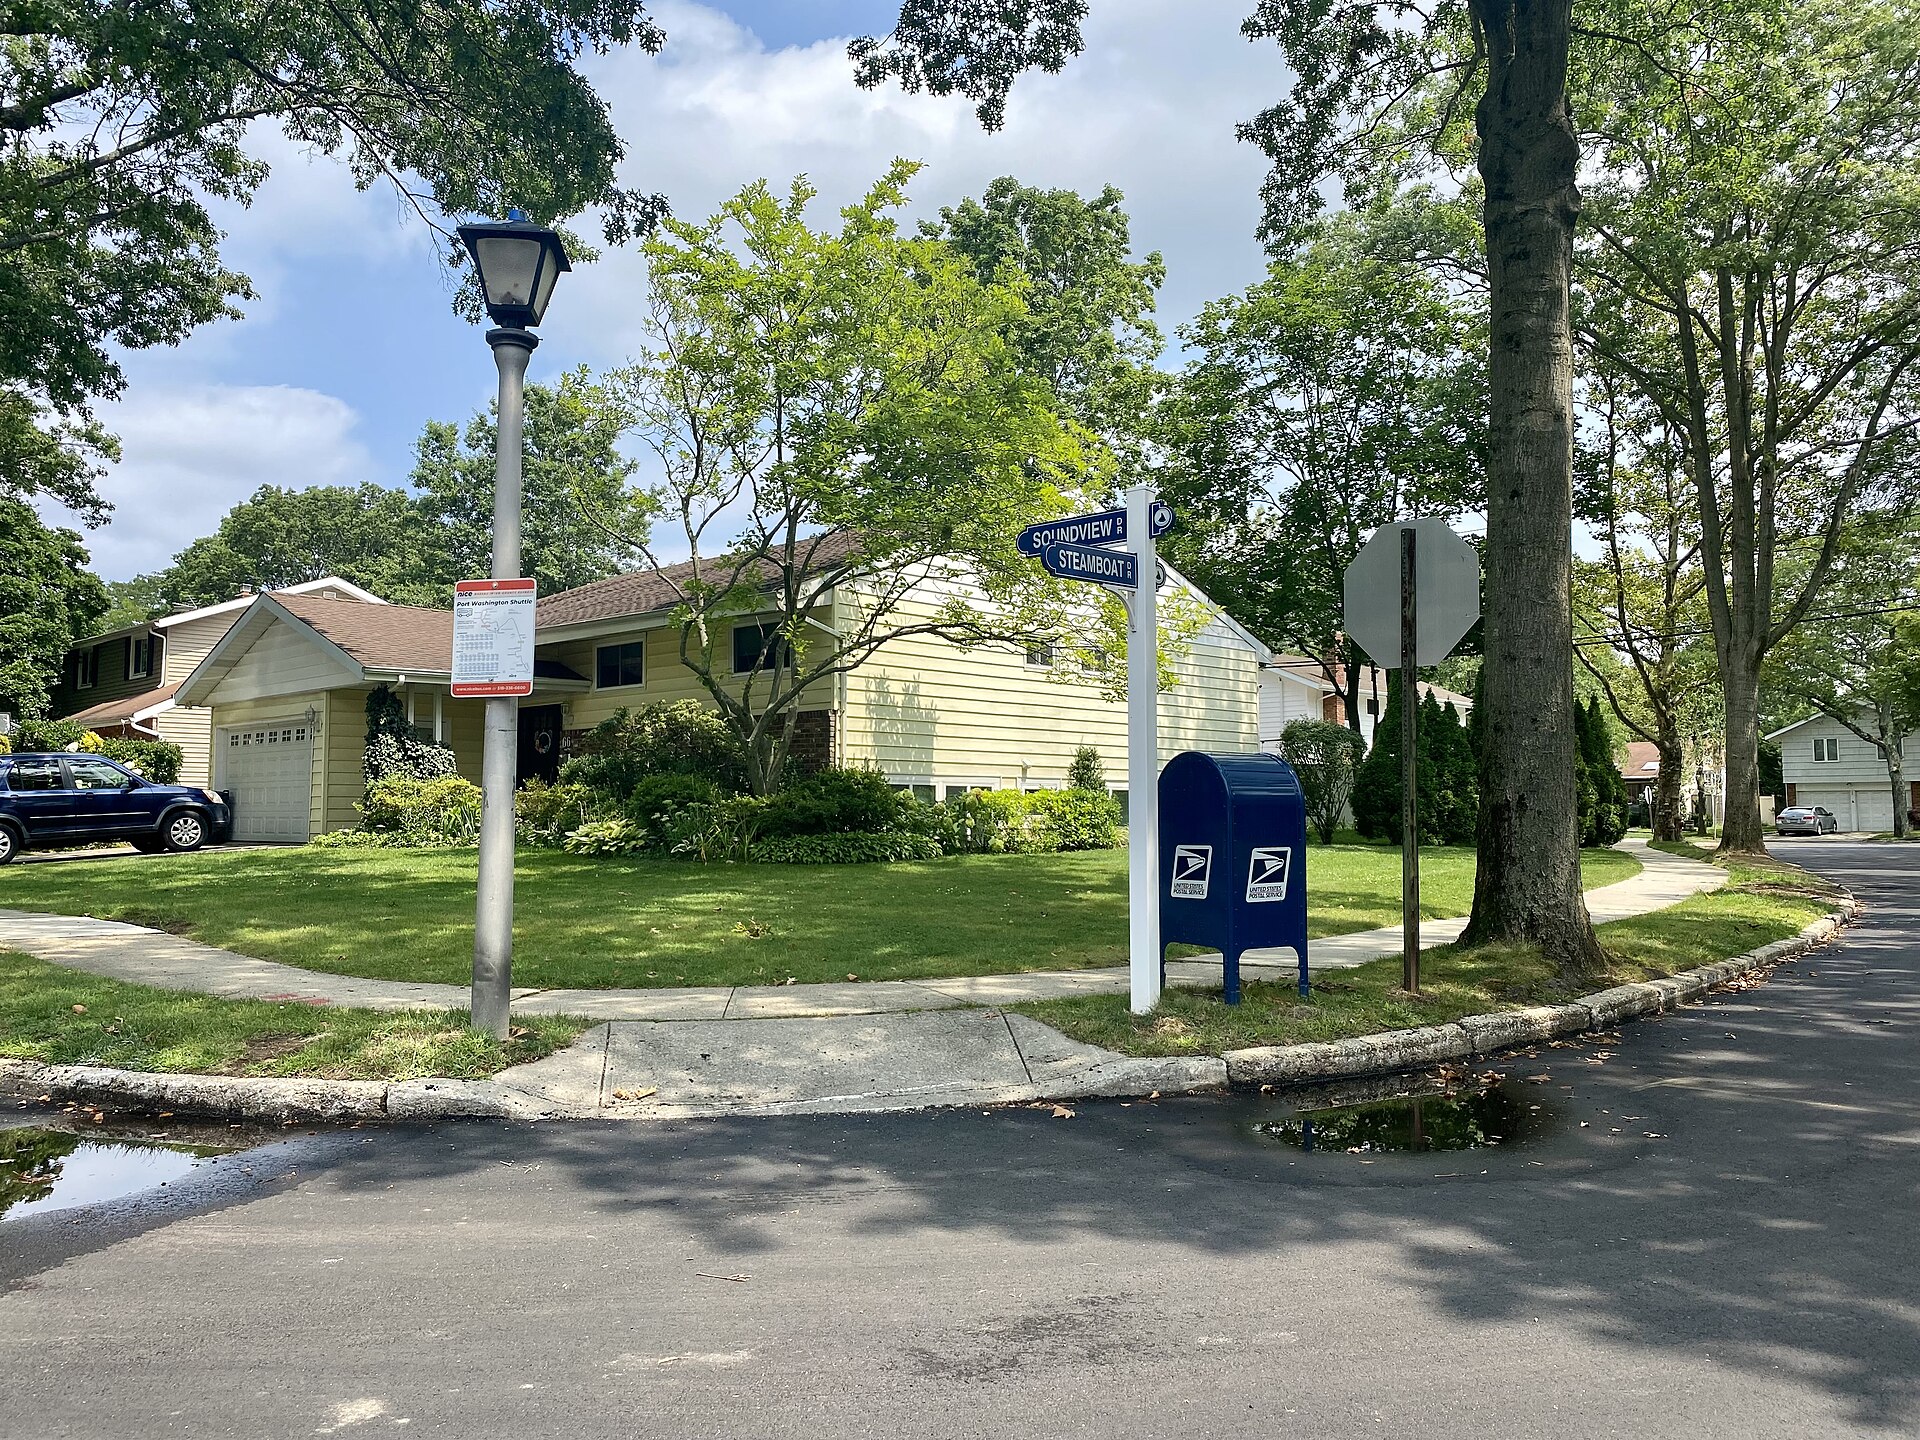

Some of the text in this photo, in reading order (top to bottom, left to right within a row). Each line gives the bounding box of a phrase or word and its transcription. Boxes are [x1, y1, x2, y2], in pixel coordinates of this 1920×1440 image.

[1033, 519, 1113, 549] SOUNDVIEW
[1059, 549, 1124, 578] STEAMBOAT
[562, 736, 571, 747] 66
